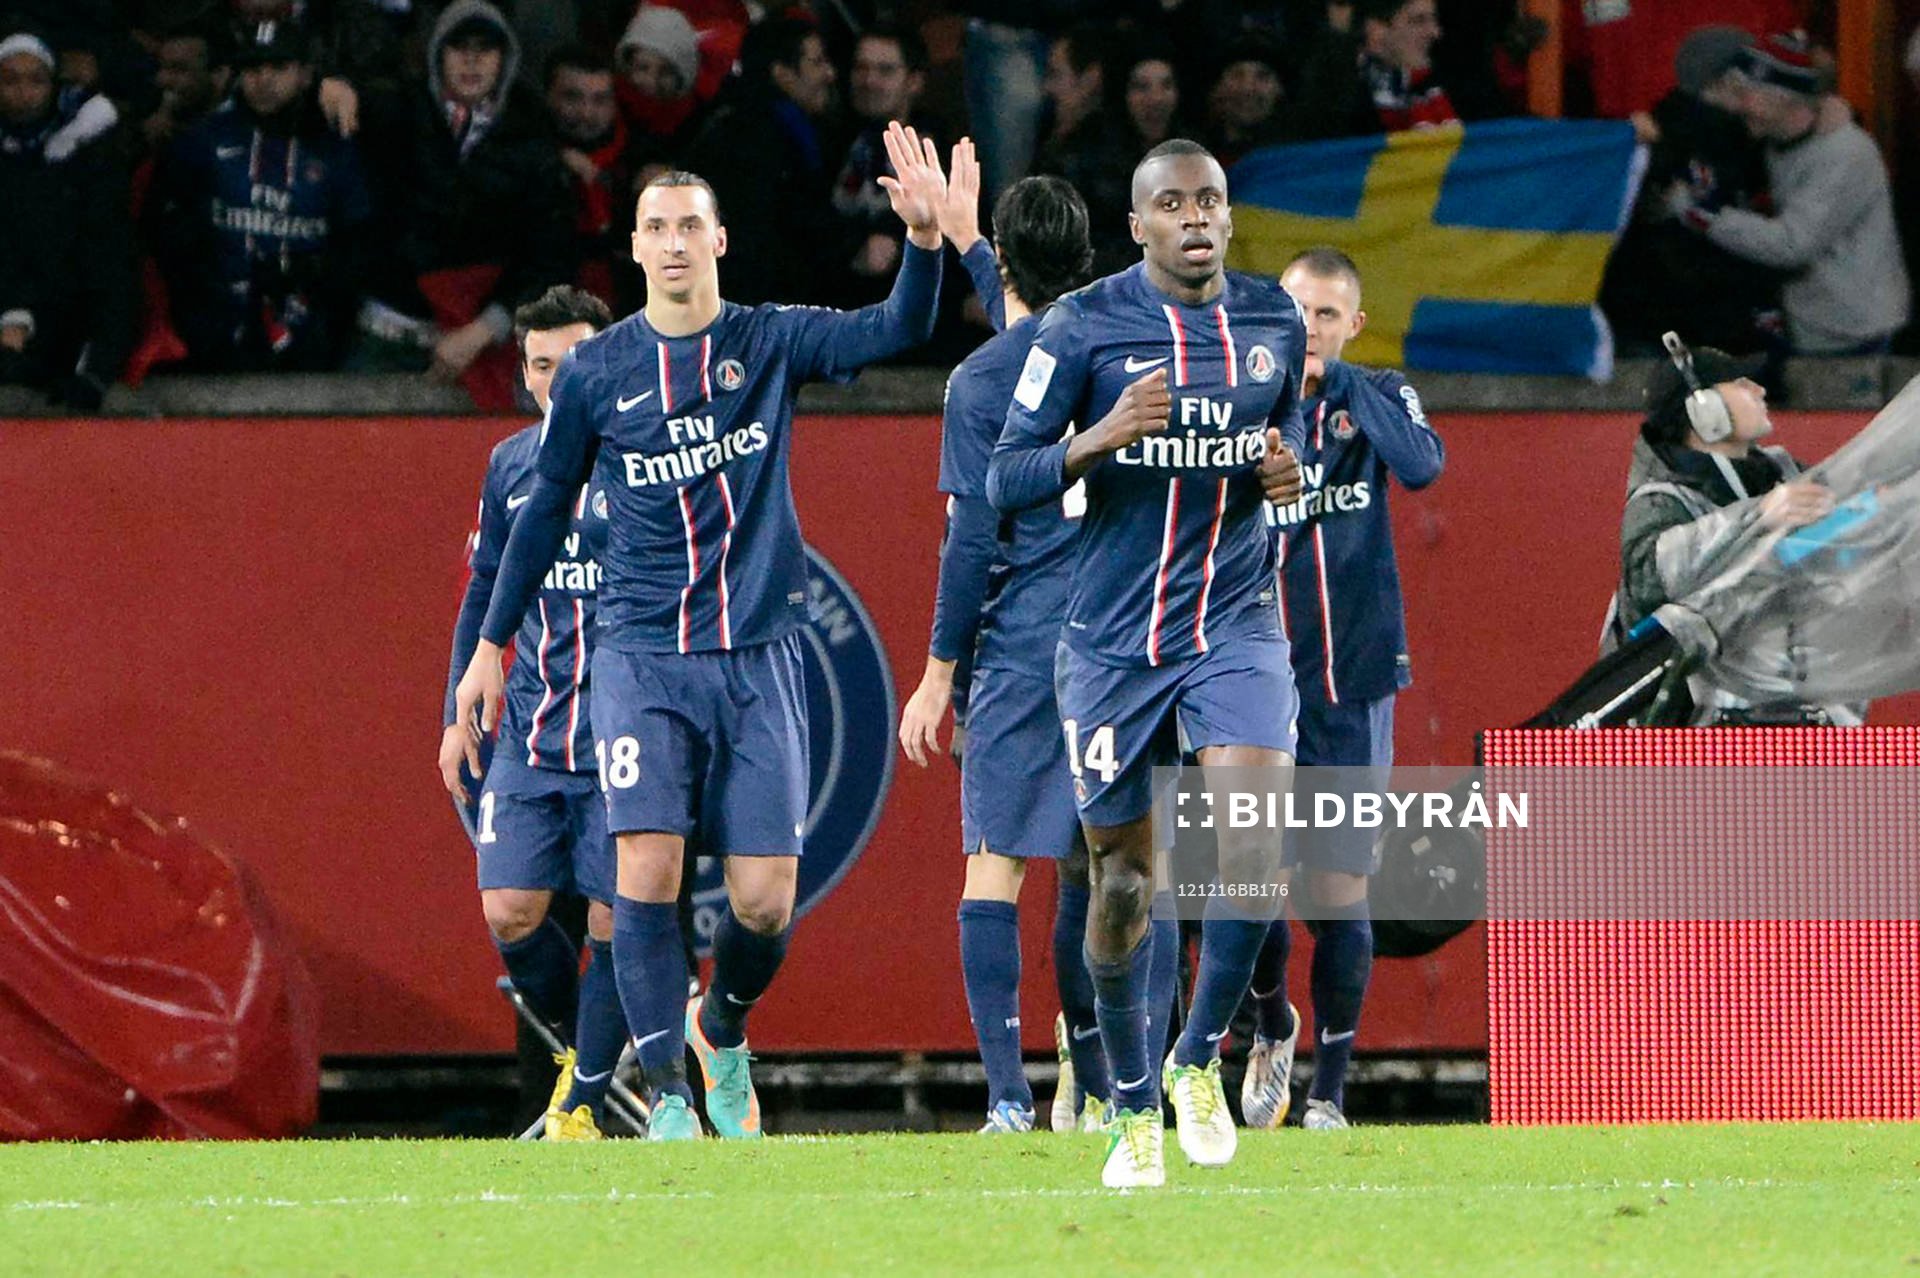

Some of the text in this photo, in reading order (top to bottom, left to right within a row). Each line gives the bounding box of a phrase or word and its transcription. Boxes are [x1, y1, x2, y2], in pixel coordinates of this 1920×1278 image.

[666, 415, 715, 444] Fly
[1180, 397, 1233, 431] Fly
[622, 421, 768, 487] Emirates
[595, 735, 640, 793] 18
[1063, 719, 1119, 783] 14
